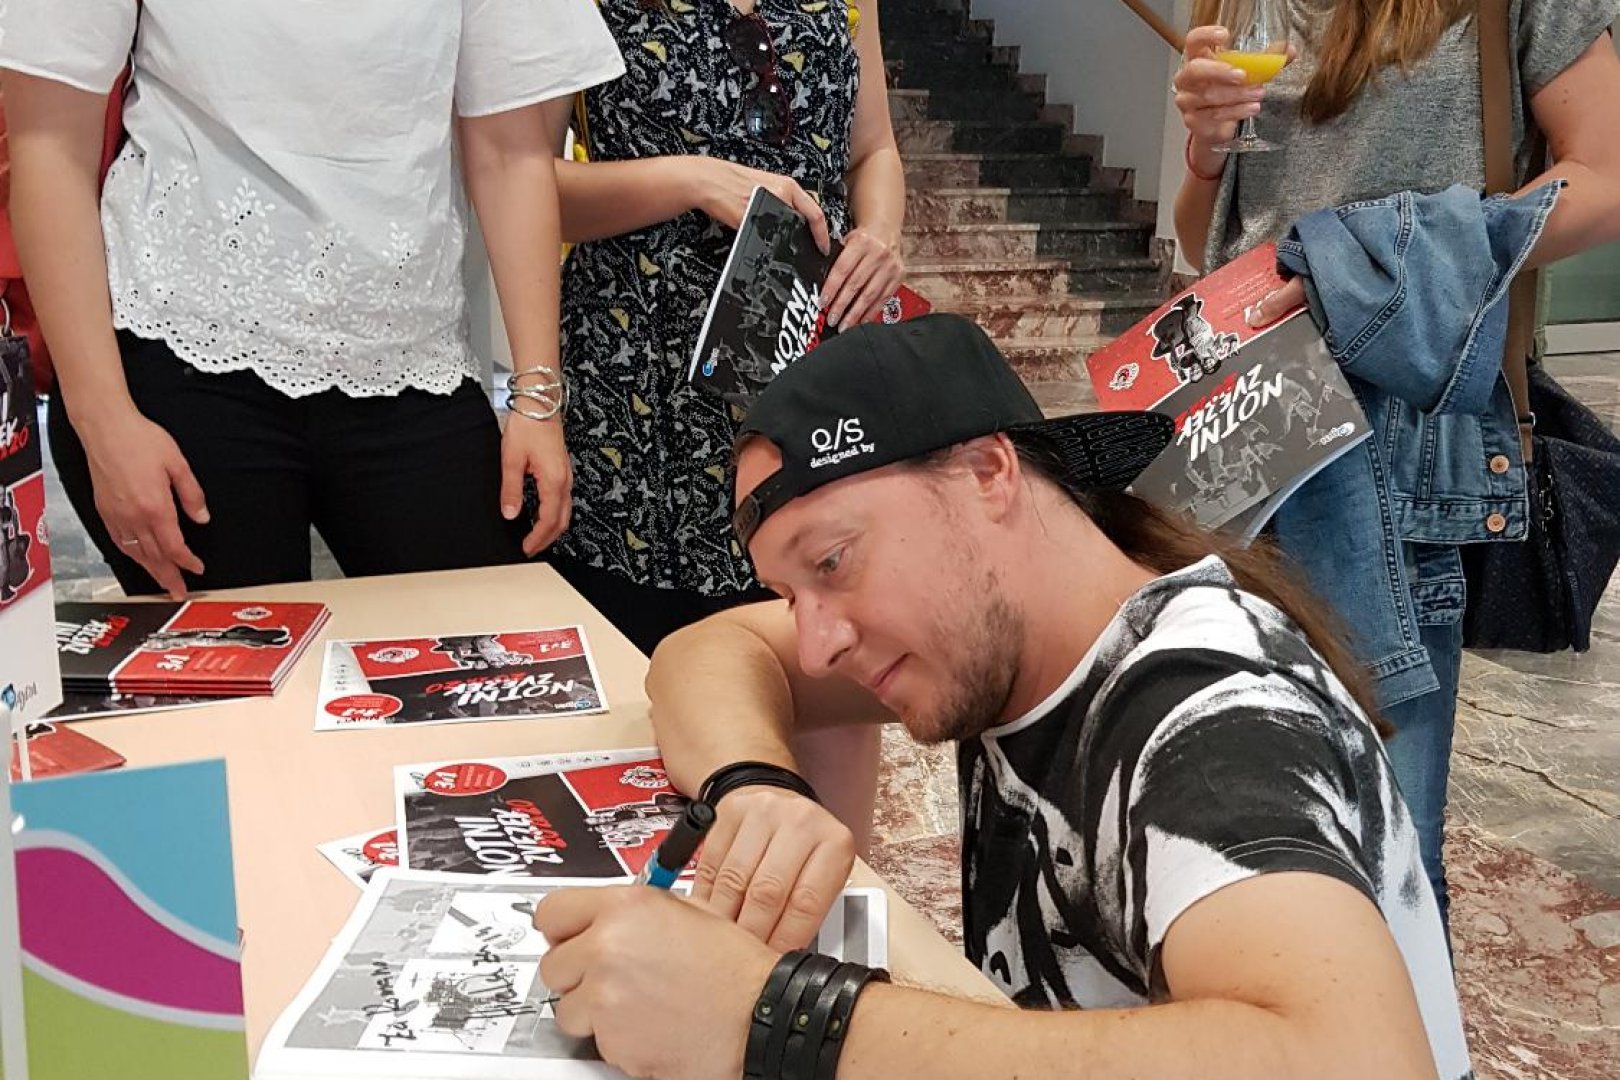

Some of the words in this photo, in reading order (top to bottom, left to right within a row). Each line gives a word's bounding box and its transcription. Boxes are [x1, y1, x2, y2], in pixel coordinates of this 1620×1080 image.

[770, 278, 809, 376] NOTNI
[792, 282, 822, 362] VEZEK
[1176, 363, 1263, 446] ZVEZEK
[1190, 372, 1283, 462] NOTNI
[810, 445, 860, 468] designed
[457, 680, 574, 707] NOTNI
[491, 808, 564, 865] ZVEZEK
